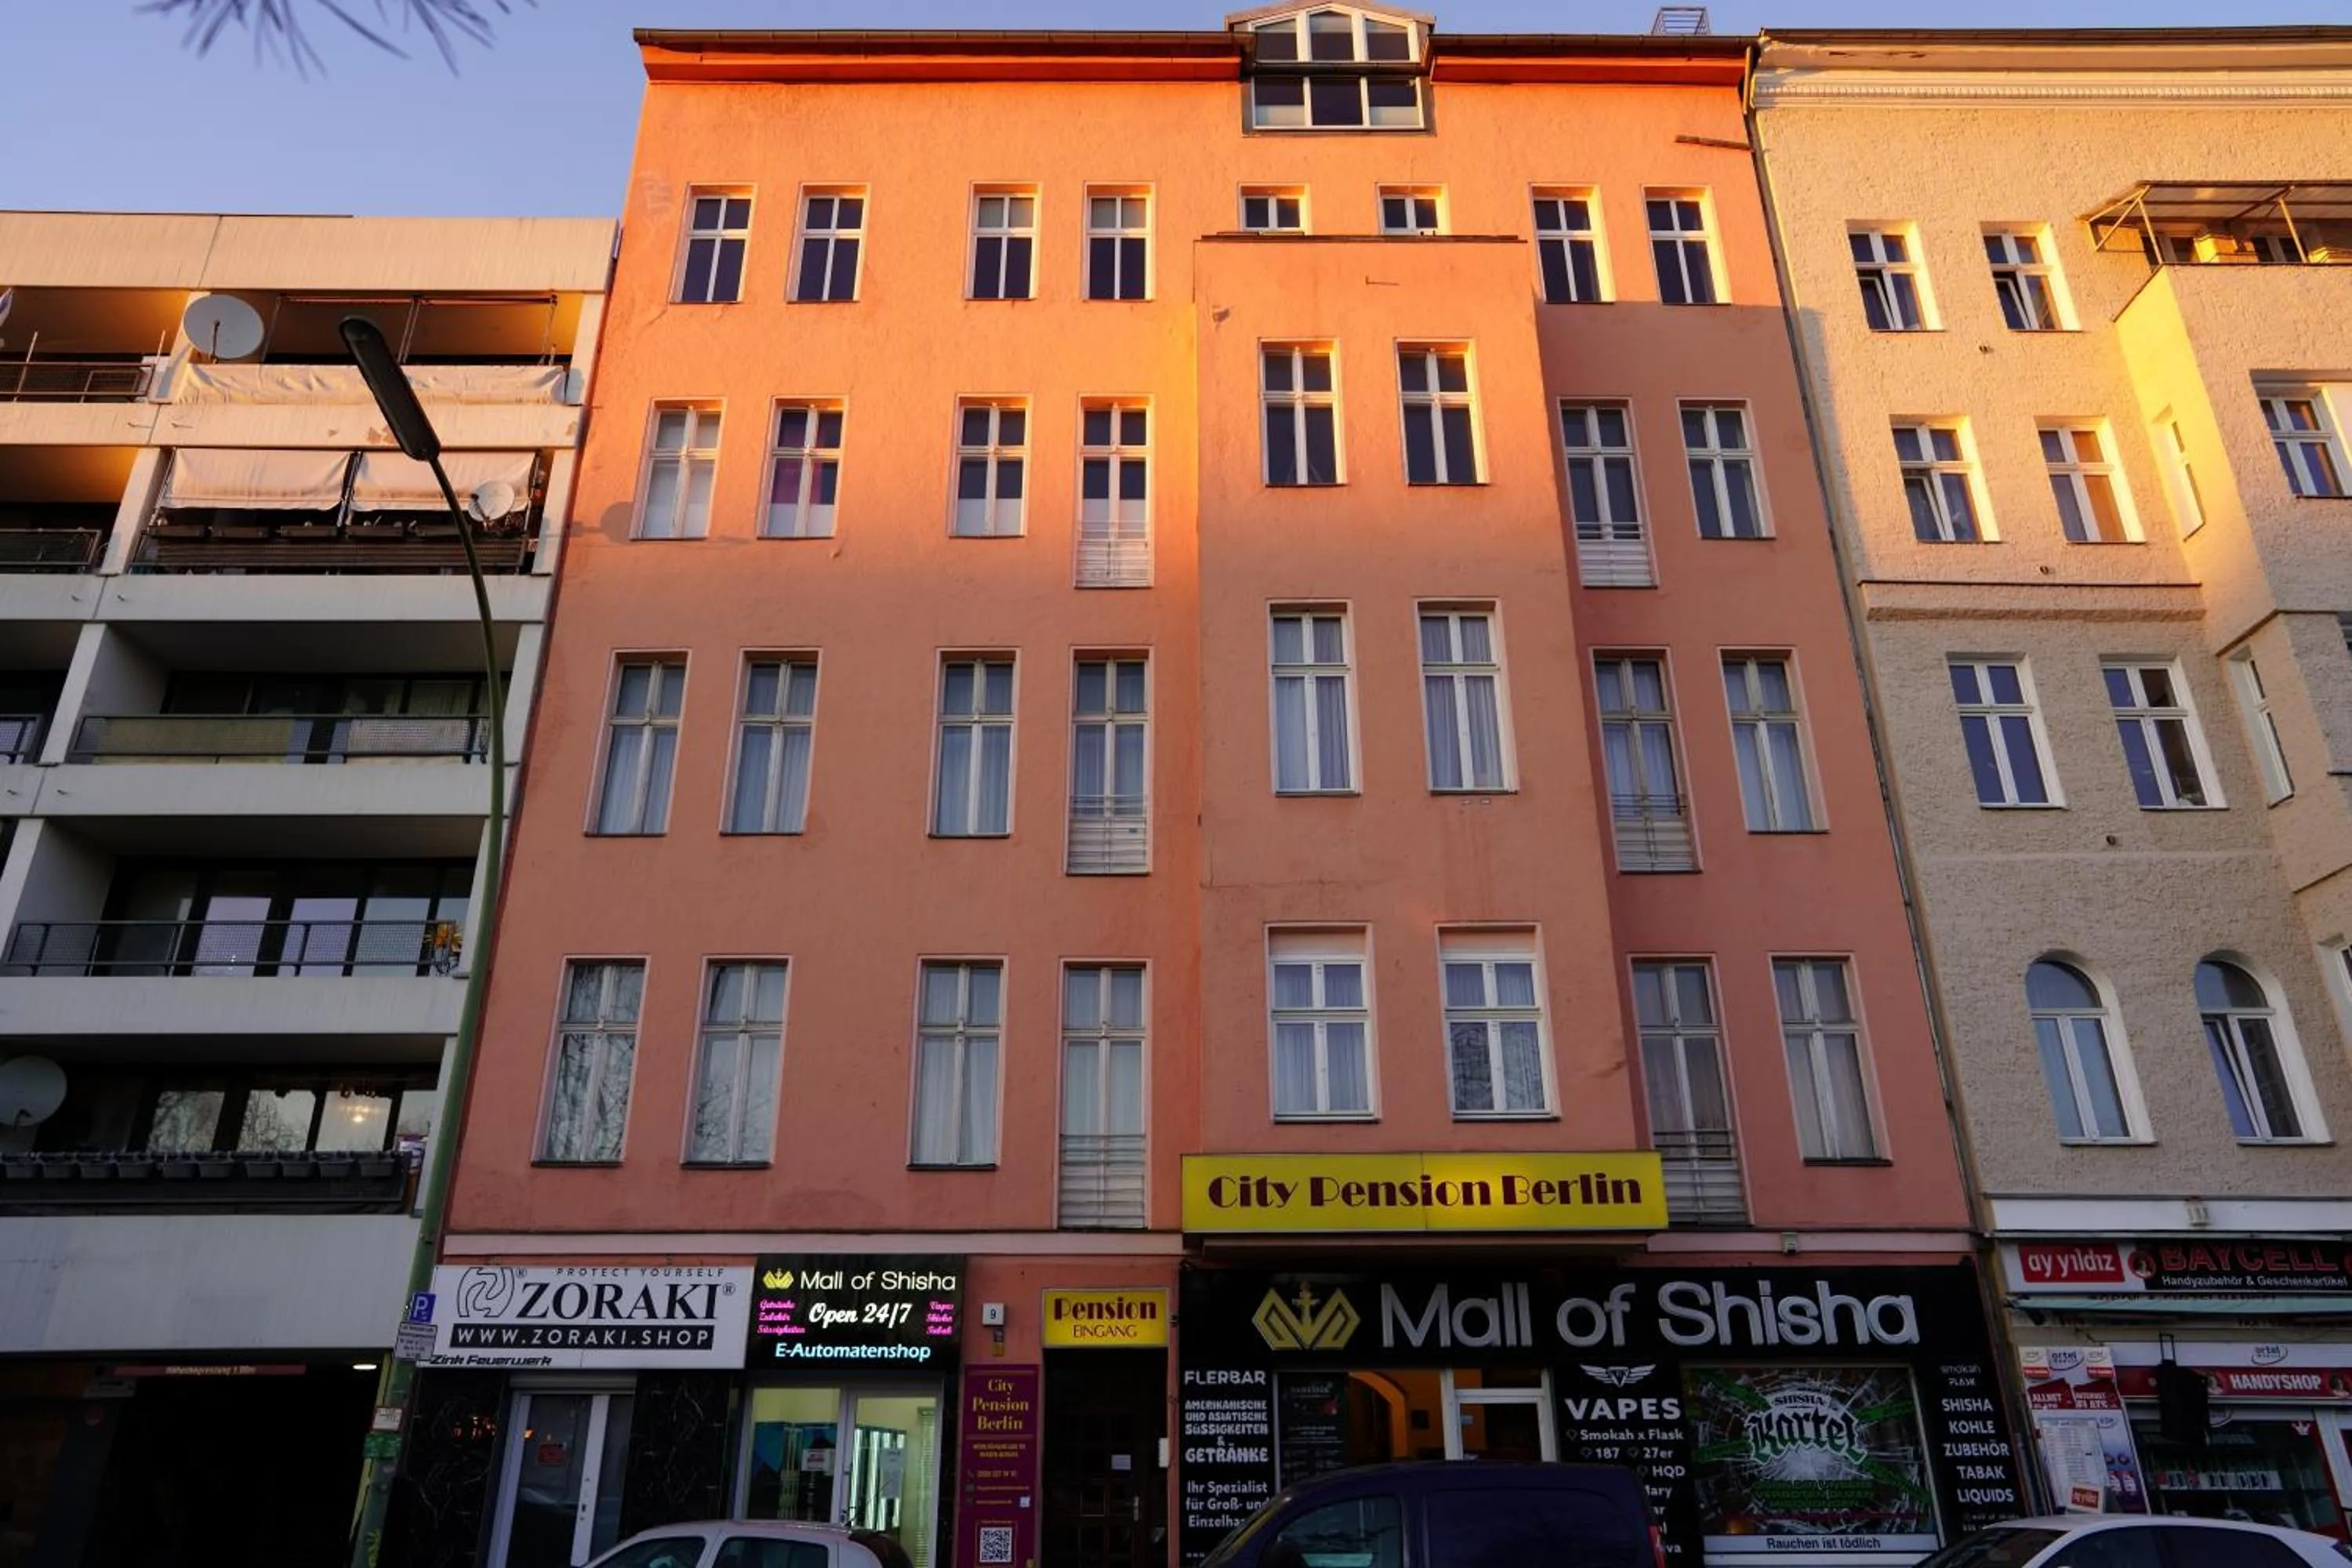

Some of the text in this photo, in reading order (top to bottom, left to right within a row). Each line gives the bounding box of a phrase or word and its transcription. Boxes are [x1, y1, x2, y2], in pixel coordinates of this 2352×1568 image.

[1208, 1173, 1641, 1208] City Pension Berlin
[2027, 1253, 2052, 1278] ay
[2160, 1243, 2339, 1272] BAYCELL
[556, 1268, 724, 1277] PROTECT YOURSELF
[800, 1271, 956, 1290] Mall of Shisha
[2161, 1274, 2242, 1287] Handyzubehör
[2246, 1276, 2255, 1286] &
[413, 1295, 429, 1318] P
[516, 1283, 722, 1319] ZORAKI
[1054, 1298, 1156, 1320] Pension
[808, 1302, 913, 1329] Open 24/7
[989, 1308, 996, 1319] 9
[1380, 1279, 1920, 1348] Mall of Shisha
[457, 1328, 709, 1346] WWW.ZORAKI.SHOP
[1073, 1324, 1138, 1338] EINGANG
[775, 1341, 931, 1363] E-Automatenshop
[430, 1355, 553, 1366] Zink Feuerwerk
[1183, 1370, 1267, 1385] FLERBAR
[2229, 1373, 2322, 1391] HANDYSHOP
[988, 1379, 1015, 1395] City
[973, 1396, 1029, 1412] Pension
[1185, 1399, 1269, 1410] AMERIKANISCHE
[1774, 1394, 1825, 1406] SHISHA
[1941, 1398, 1994, 1412] SHISHA
[1185, 1411, 1268, 1421] UND ASIATISCHE
[1564, 1397, 1682, 1421] VAPES
[978, 1414, 1023, 1431] Berlin
[1948, 1420, 1996, 1434] KOHLE
[1216, 1436, 1226, 1446] &
[1580, 1429, 1685, 1441] Smokah x Flask
[1745, 1407, 1864, 1464] Kartel
[1185, 1442, 1269, 1464] GETRÄNKE
[1595, 1447, 1674, 1459] 187 27er
[1942, 1439, 2011, 1457] ZUBEHÖR
[1652, 1465, 1686, 1478] HQD
[1957, 1465, 2006, 1479] TABAK
[1187, 1480, 1268, 1496] Ihr Spezialist
[1185, 1497, 1204, 1511] für
[1207, 1497, 1243, 1511] Groß-
[1957, 1489, 2016, 1504] LIQUIDS
[1766, 1537, 1881, 1549] Rauchen ist tödlich
